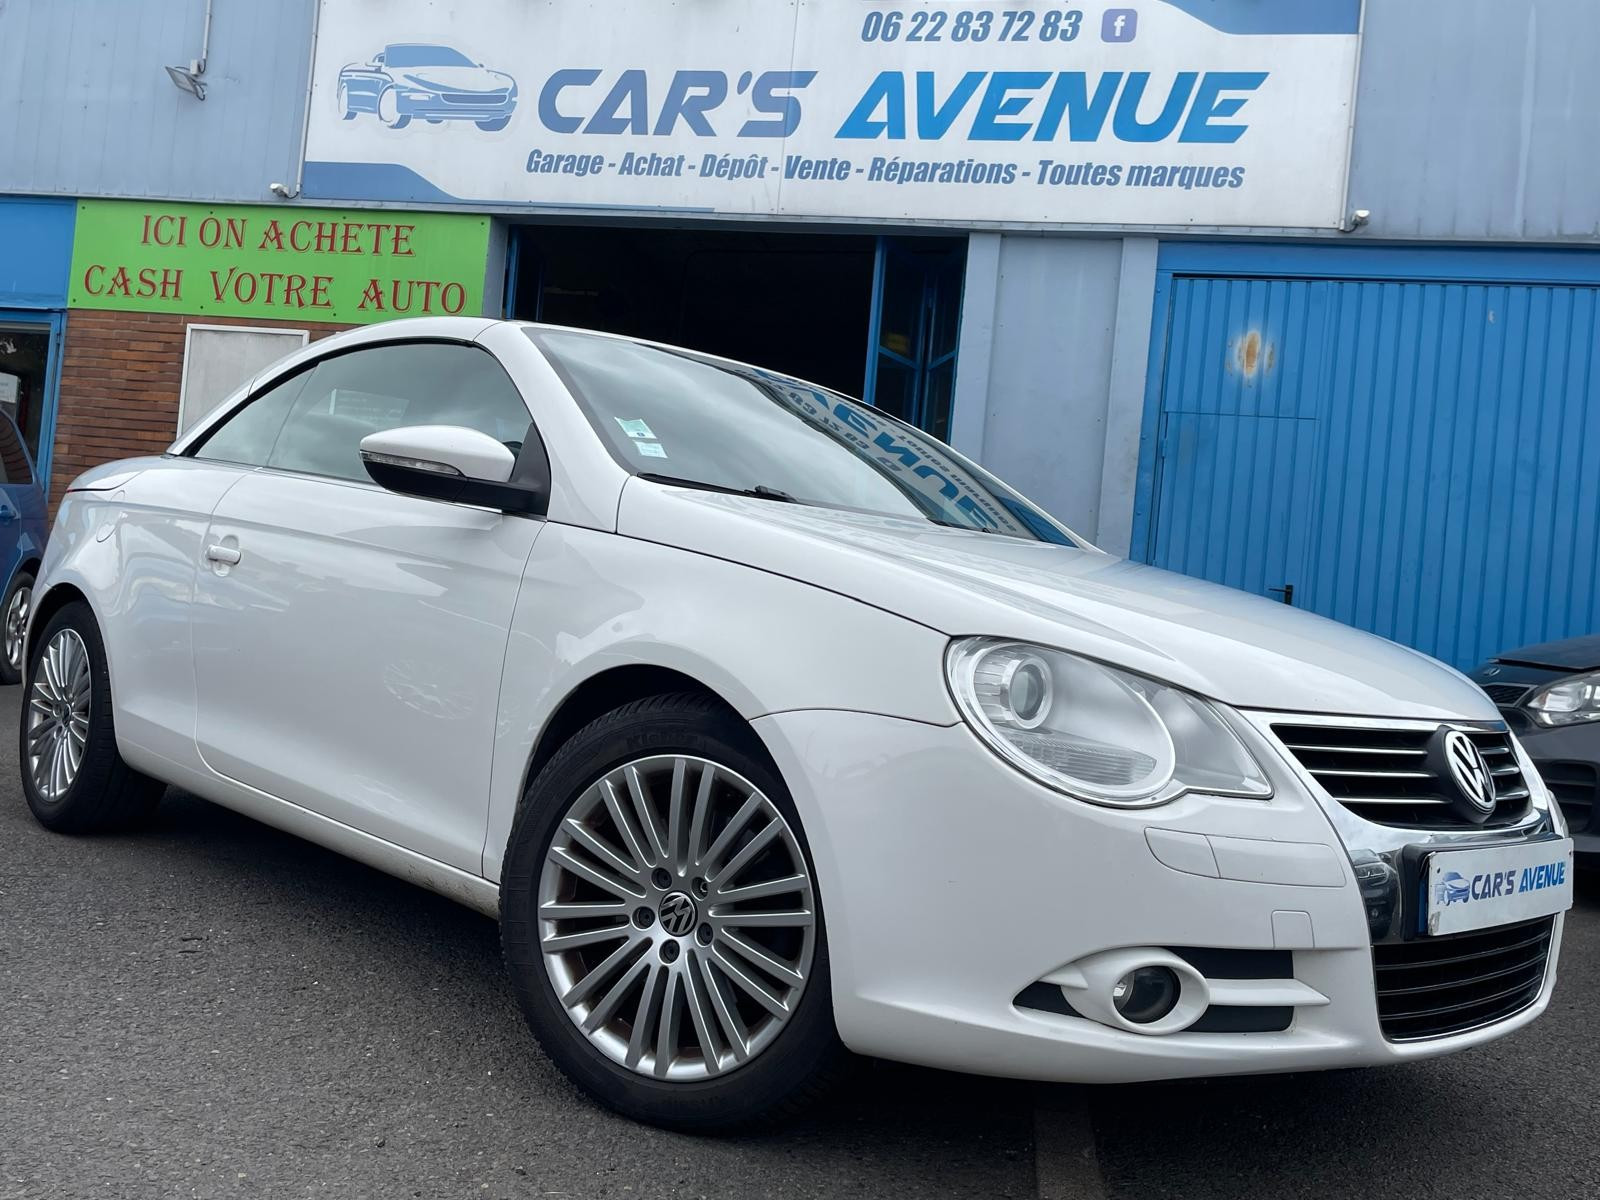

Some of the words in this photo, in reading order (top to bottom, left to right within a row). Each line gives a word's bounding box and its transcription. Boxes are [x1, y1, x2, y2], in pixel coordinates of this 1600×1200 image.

[861, 11, 903, 42] 06
[906, 11, 946, 42] 22
[951, 11, 994, 42] 83
[999, 11, 1036, 42] 72
[1039, 11, 1083, 42] 83
[538, 68, 818, 138] CAR'S
[834, 70, 1271, 145] AVENUE
[526, 149, 604, 177] Garage
[618, 152, 686, 177] Achat
[700, 153, 768, 181] Dépôt
[784, 155, 851, 181] Vente
[867, 157, 1018, 185] Réparations
[1038, 159, 1123, 187] Toutes
[1126, 164, 1246, 190] marques
[141, 214, 187, 247] ICI
[198, 216, 249, 251] ON
[257, 219, 417, 258] ACHETE
[83, 264, 184, 300] CASH
[209, 265, 335, 309] VOTRE
[357, 278, 467, 316] AUTO
[1471, 870, 1516, 900] CAR'S
[1518, 861, 1566, 893] AVENUE
